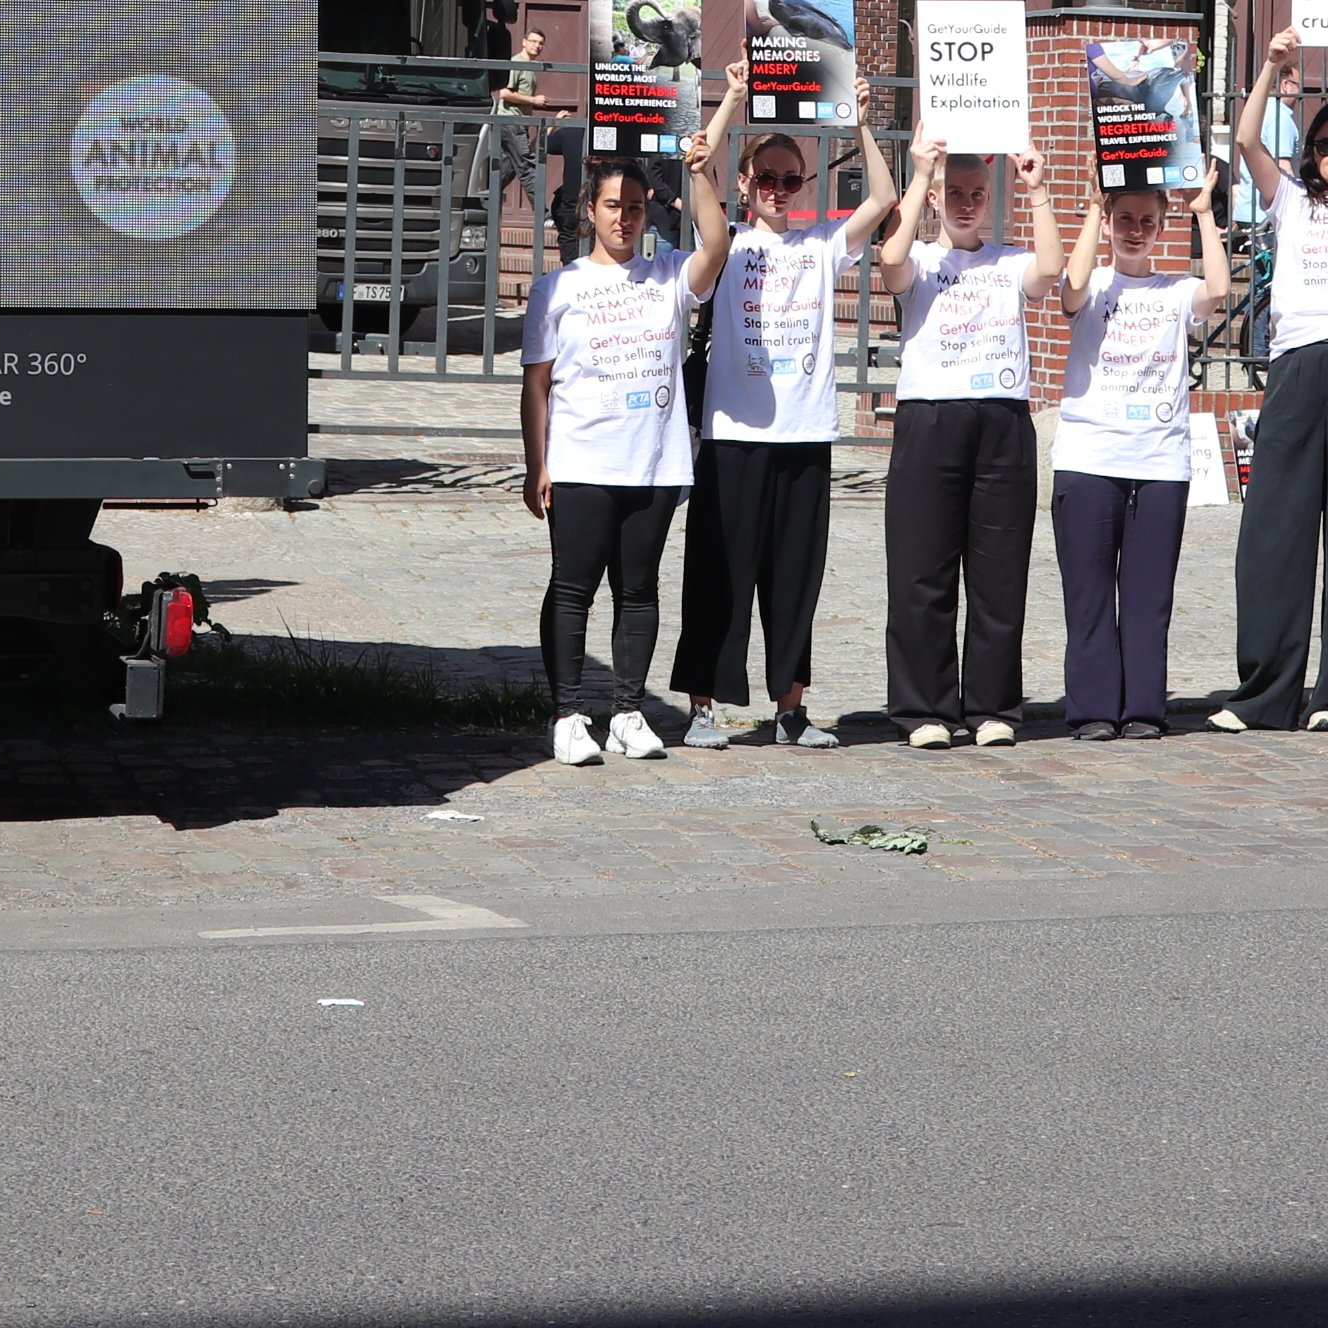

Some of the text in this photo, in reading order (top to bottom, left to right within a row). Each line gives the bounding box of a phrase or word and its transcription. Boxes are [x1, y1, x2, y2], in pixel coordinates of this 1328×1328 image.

[927, 24, 1008, 34] GetYourGuide
[751, 36, 807, 48] MAKING
[752, 50, 821, 62] MEMORIES
[930, 41, 994, 62] STOP
[595, 63, 646, 72] UNLOCK THE
[752, 63, 799, 75] MISERY
[595, 74, 657, 83] WORLD'S MOST
[929, 72, 988, 86] Wildlife
[595, 84, 678, 97] REGRETTABLE
[753, 81, 823, 92] GetYourGuide
[595, 97, 677, 108] TRAVEL EXPERIENCES
[931, 94, 1020, 112] Exploitation
[1097, 103, 1146, 114] UNLOCK THE
[594, 112, 665, 124] GetYourGuide
[1098, 113, 1157, 124] WORLD'S MOST
[1099, 121, 1177, 136] REGRETTABLE
[1100, 134, 1178, 146] TRAVEL EXPERIENCES
[83, 139, 223, 170] ANIMAL
[1101, 148, 1169, 161] GetYourGuide
[1303, 259, 1328, 269] Stop
[744, 317, 809, 332] Stop selling
[589, 328, 676, 351] GetYourGuide
[744, 335, 785, 347] animal
[940, 333, 1006, 353] Stop selling
[592, 346, 663, 367] Stop selling
[941, 354, 982, 368] animal
[27, 352, 88, 376] 360°
[597, 367, 639, 384] animal
[1103, 366, 1128, 380] Stop
[1101, 383, 1140, 394] animal
